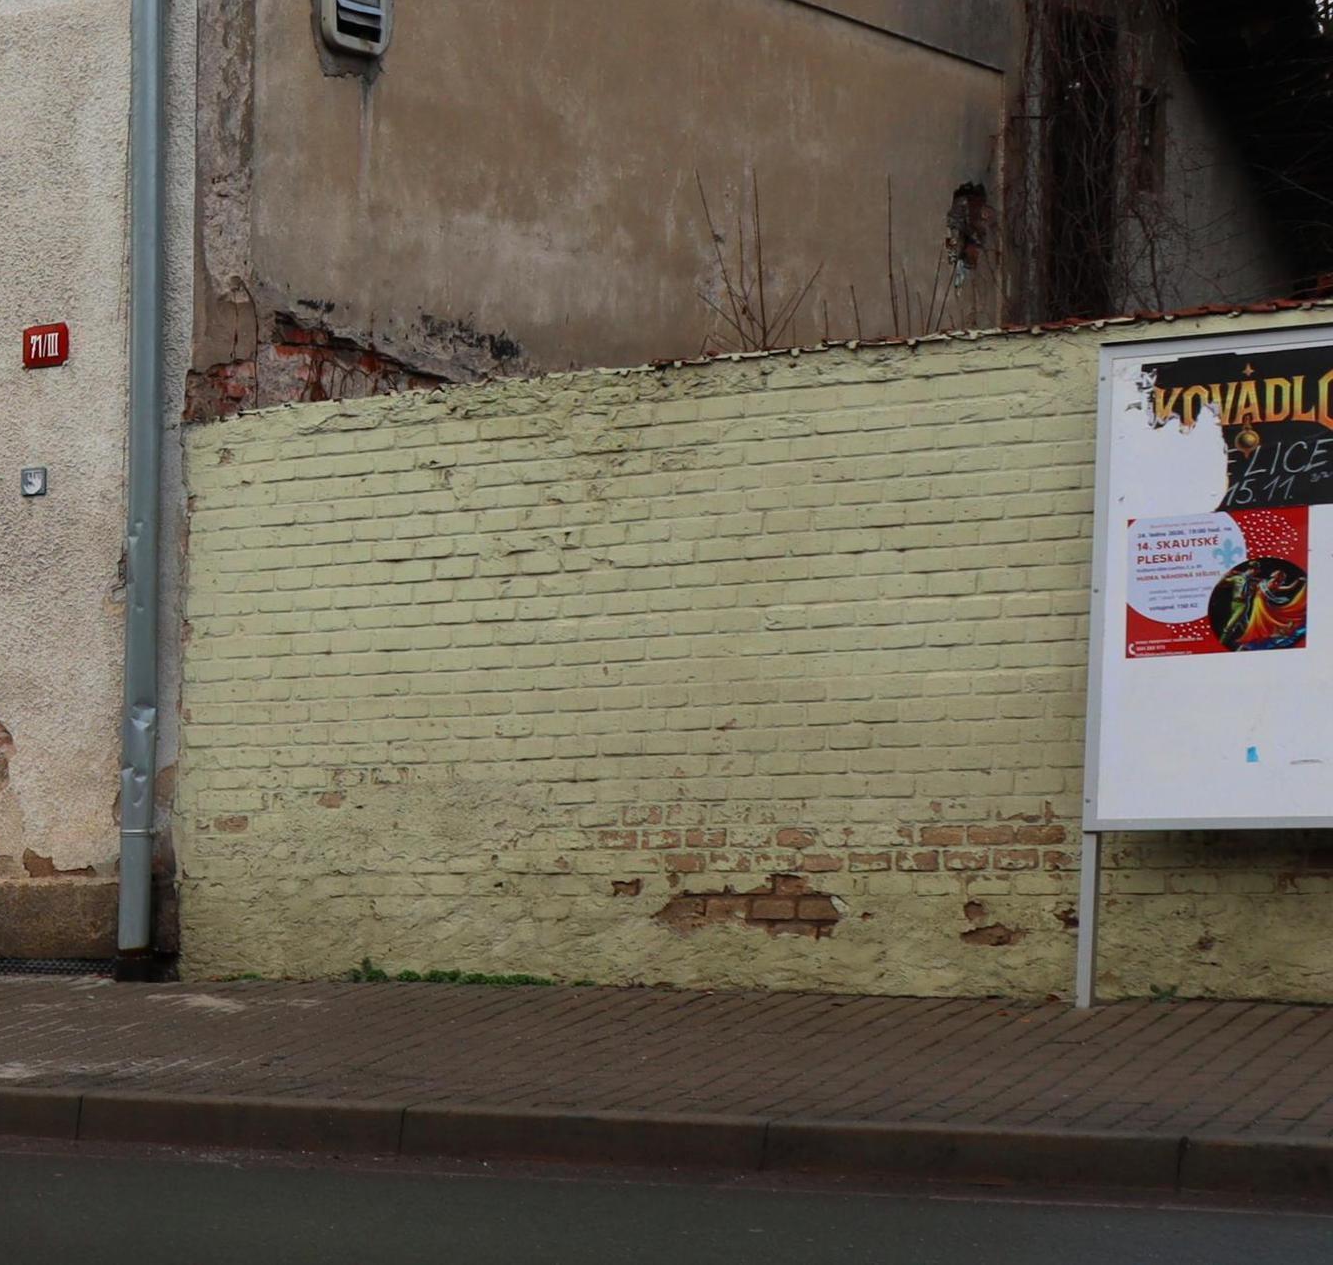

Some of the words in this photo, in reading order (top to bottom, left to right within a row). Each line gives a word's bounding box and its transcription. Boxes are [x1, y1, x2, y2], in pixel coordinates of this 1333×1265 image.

[30, 332, 59, 359] 71/III
[1156, 536, 1219, 550] SKAUTSKÉ
[1137, 551, 1193, 564] PLESkání
